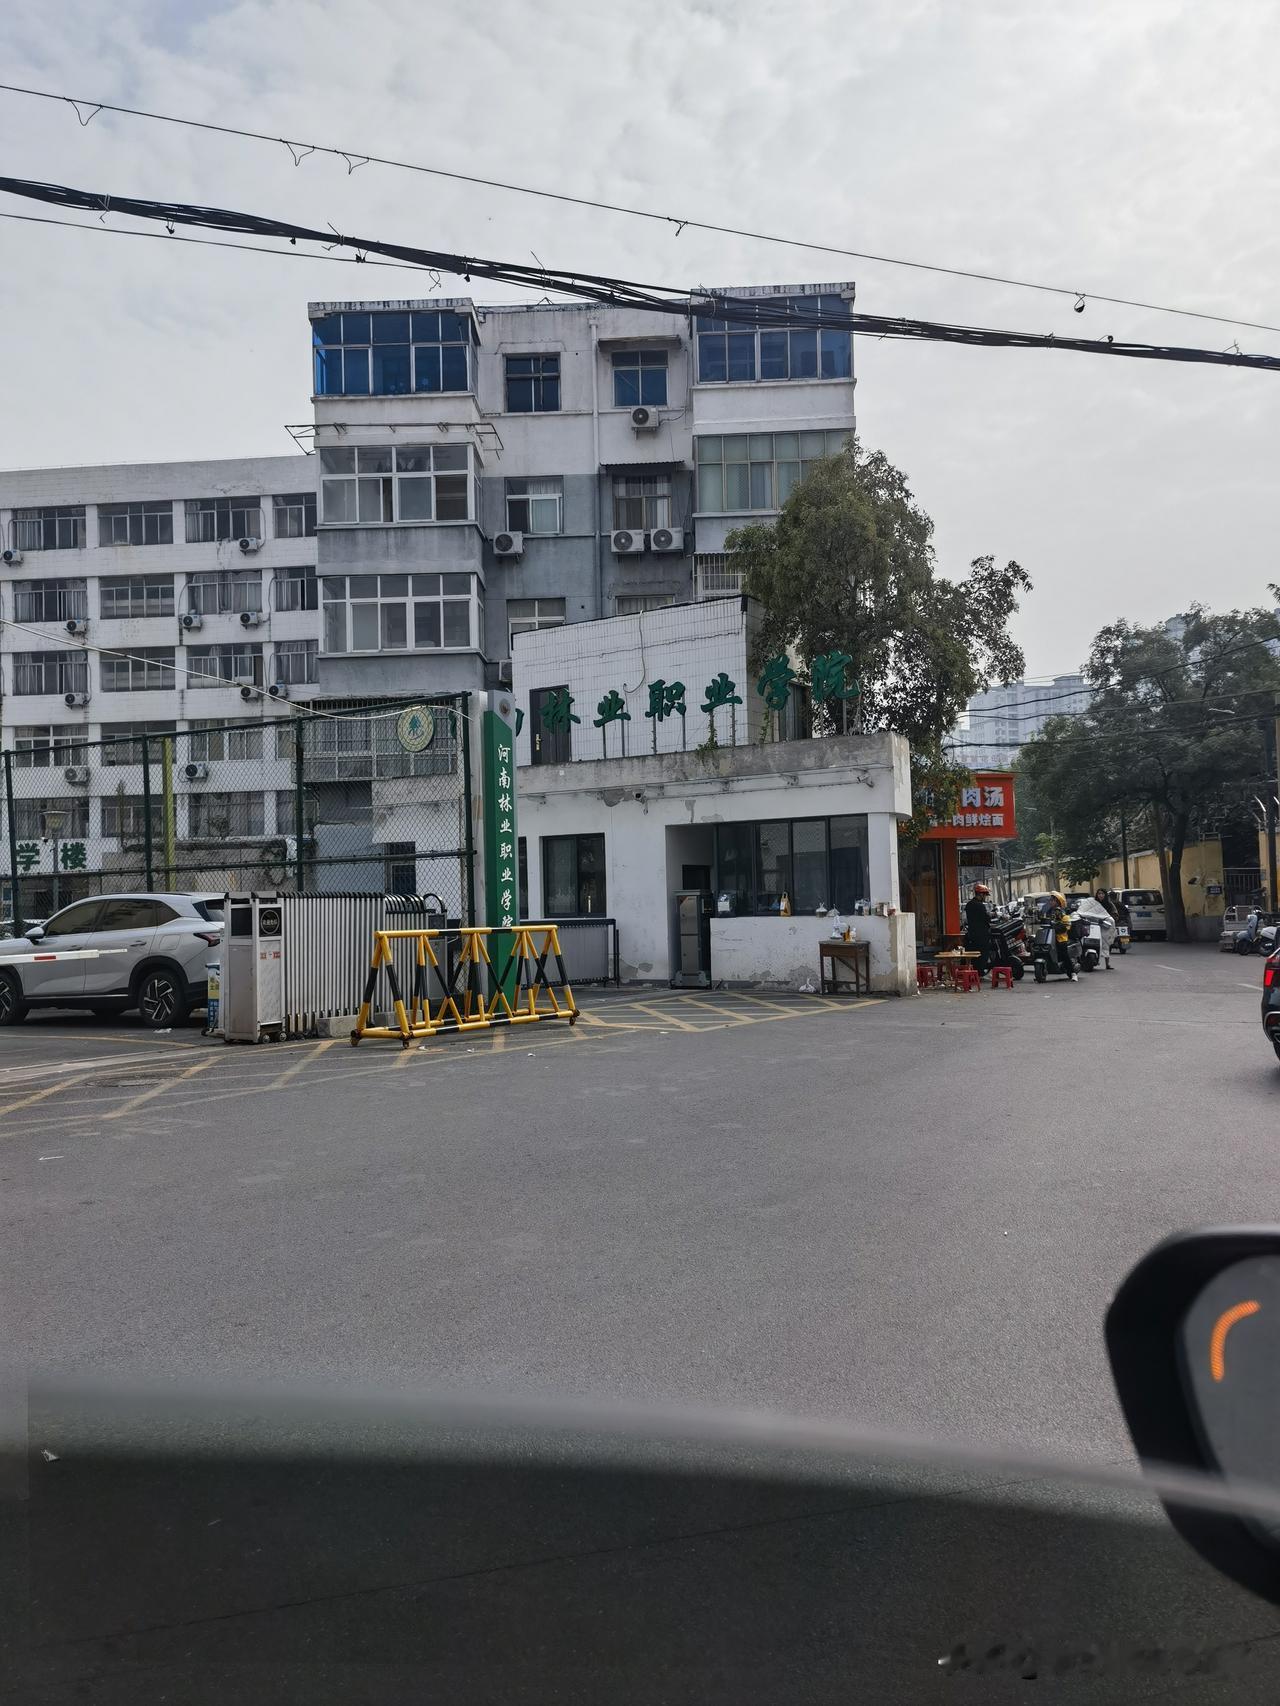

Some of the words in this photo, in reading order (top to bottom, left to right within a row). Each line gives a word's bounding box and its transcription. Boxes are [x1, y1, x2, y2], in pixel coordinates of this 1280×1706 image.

[448, 650, 861, 738] 林业职业学院
[930, 813, 1004, 827] 肉鲜烩面
